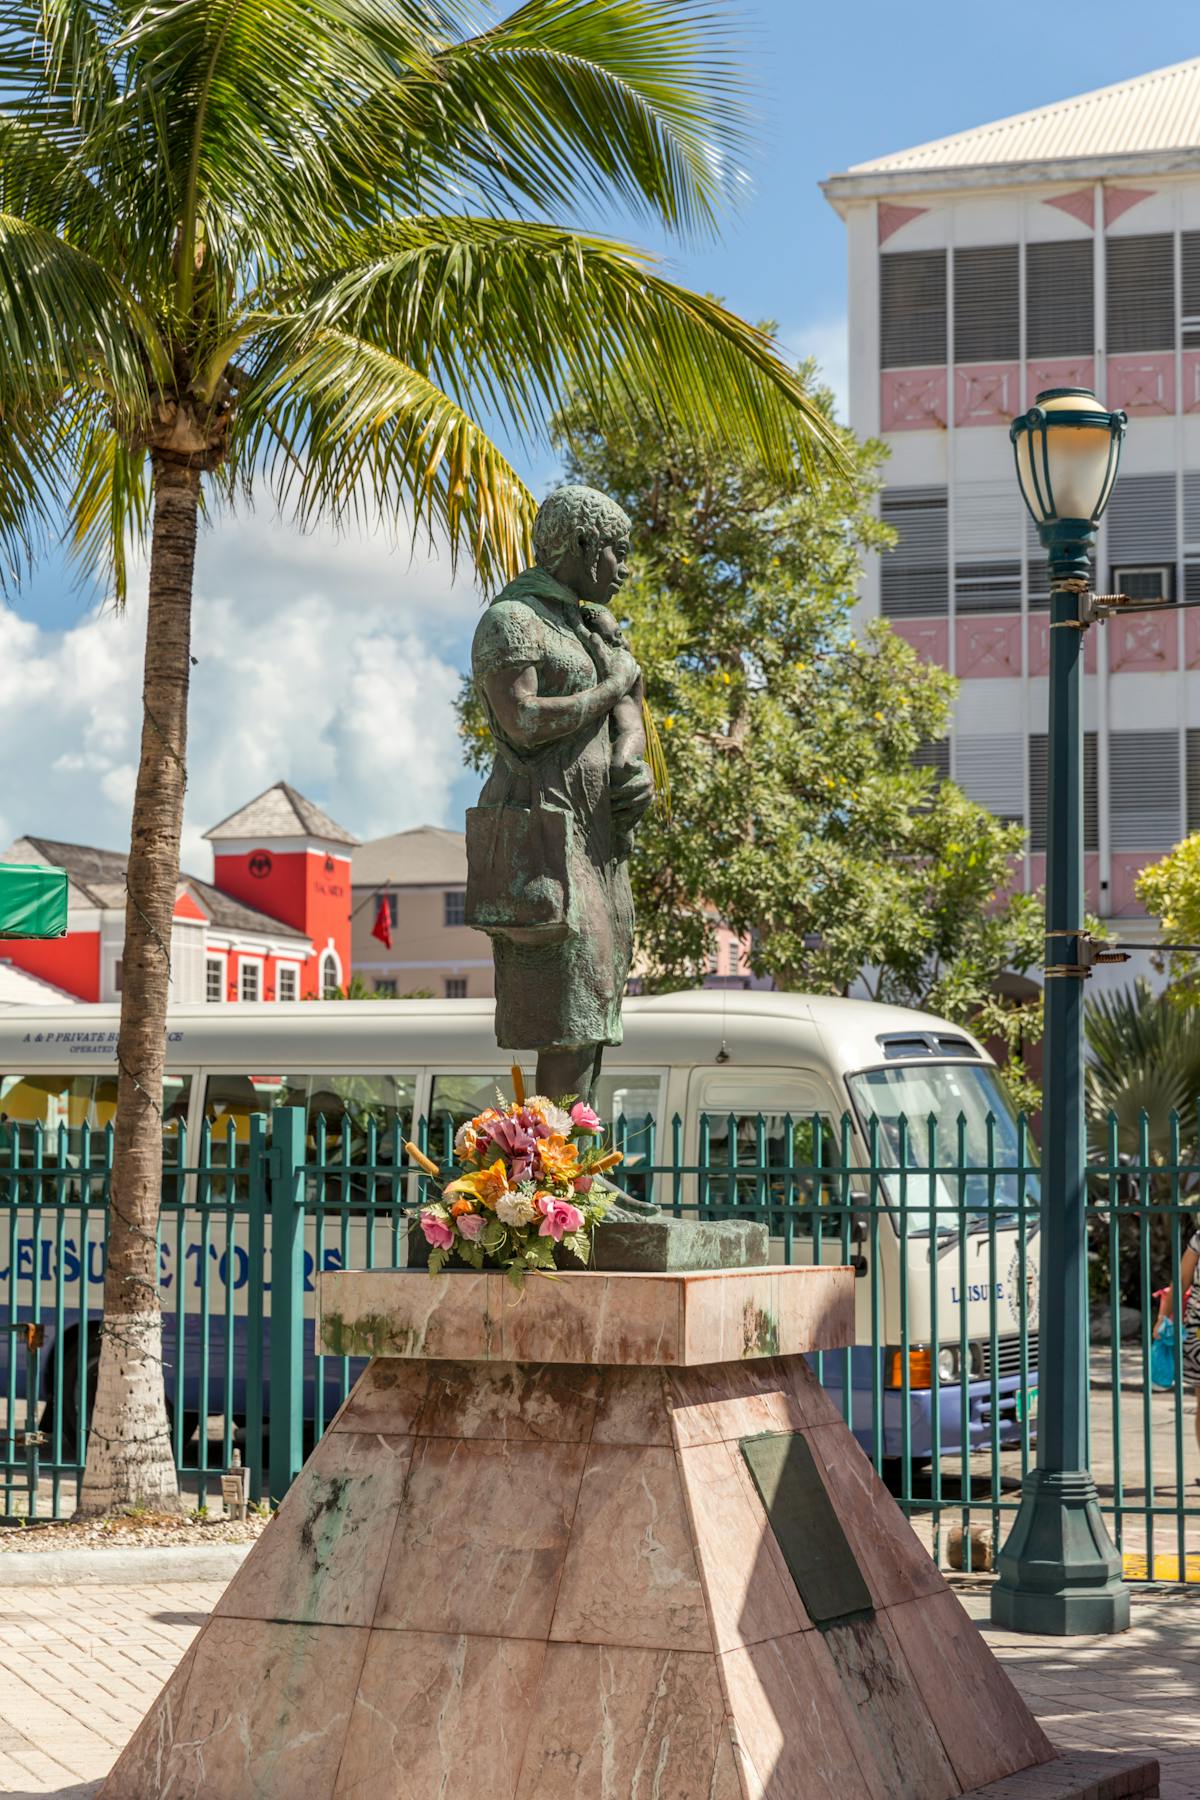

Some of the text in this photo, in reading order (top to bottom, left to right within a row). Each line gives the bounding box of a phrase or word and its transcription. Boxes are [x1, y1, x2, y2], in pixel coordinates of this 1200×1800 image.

[22, 1032, 31, 1043] A
[34, 1032, 44, 1043] &
[45, 1032, 55, 1043] P
[55, 1031, 105, 1043] PRIVATE
[0, 1238, 342, 1293] EISUE TORS
[950, 1282, 1005, 1304] LISUE
